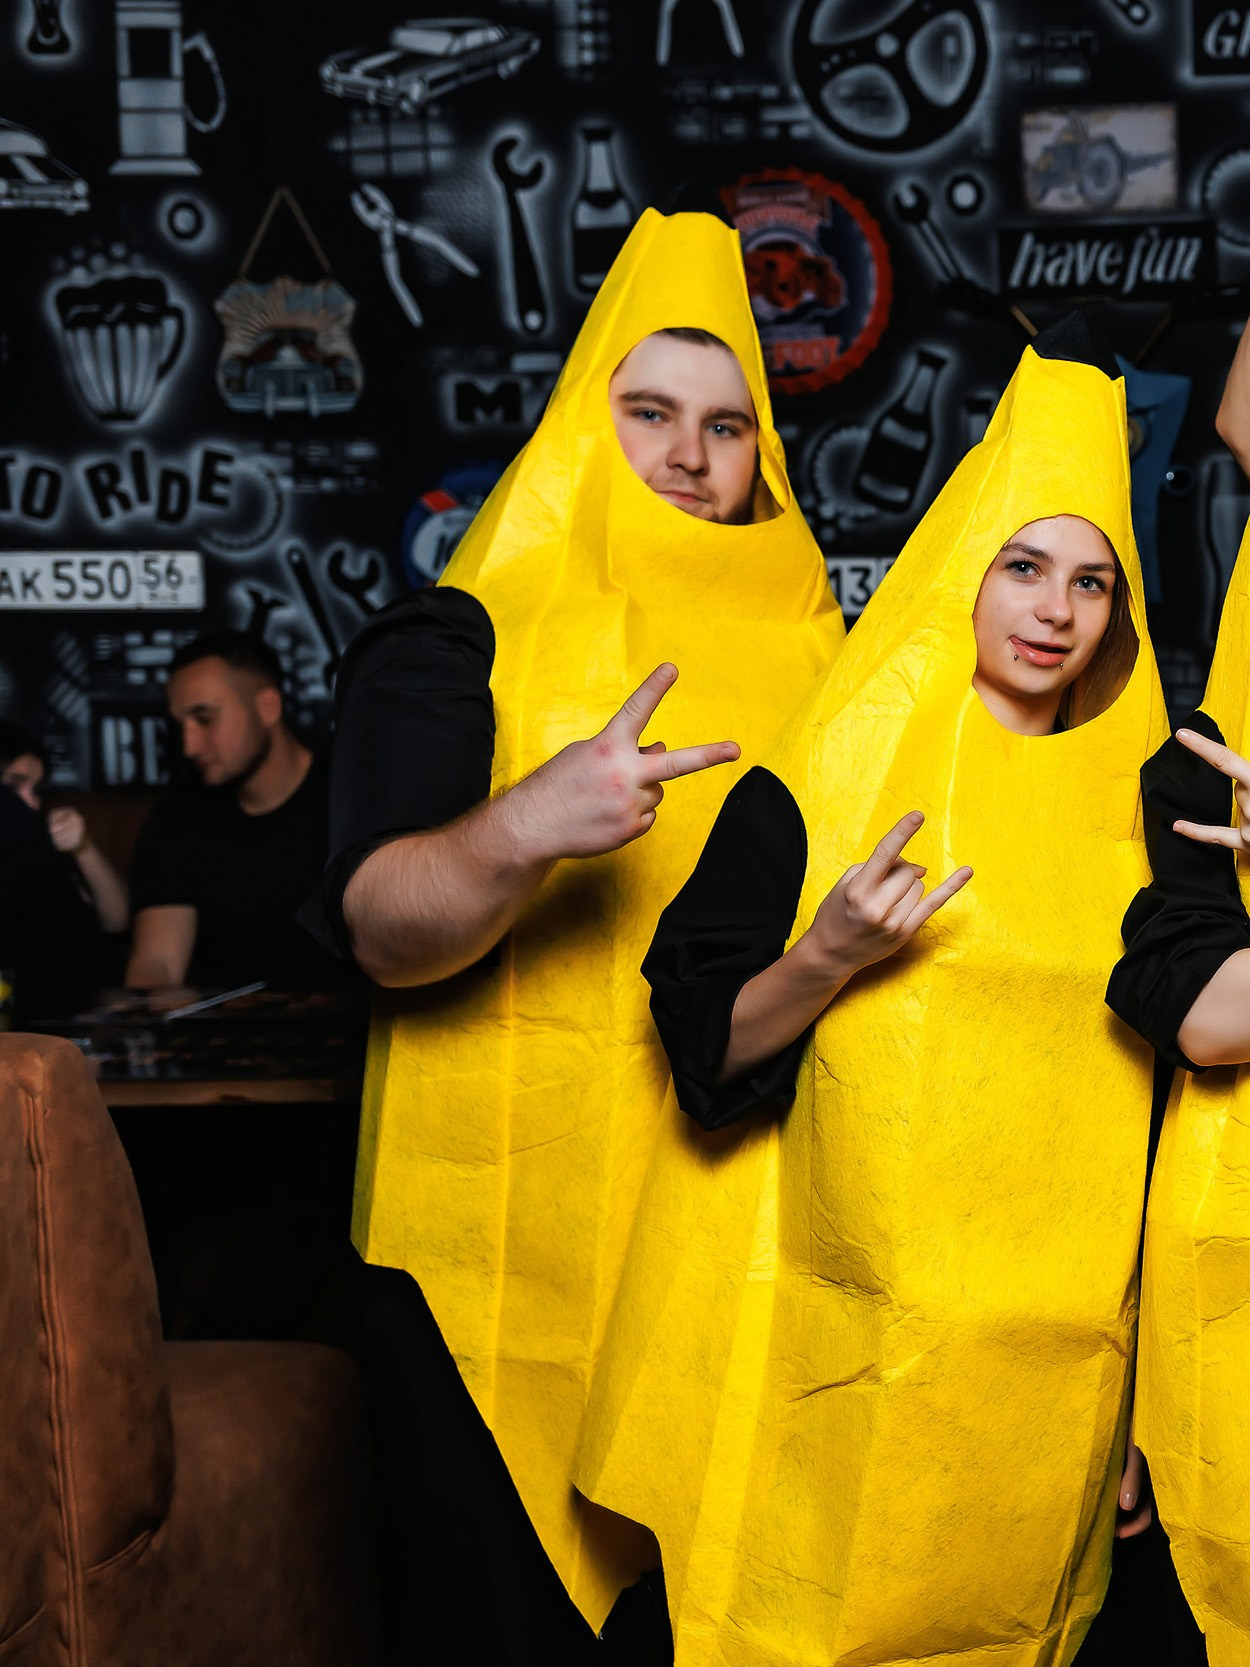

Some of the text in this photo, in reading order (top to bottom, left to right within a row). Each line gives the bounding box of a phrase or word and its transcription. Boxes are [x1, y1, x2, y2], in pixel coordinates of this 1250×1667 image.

[1008, 226, 1201, 295] have fun
[84, 449, 234, 523] RIDE
[52, 559, 132, 601] 550
[143, 553, 184, 590] 56
